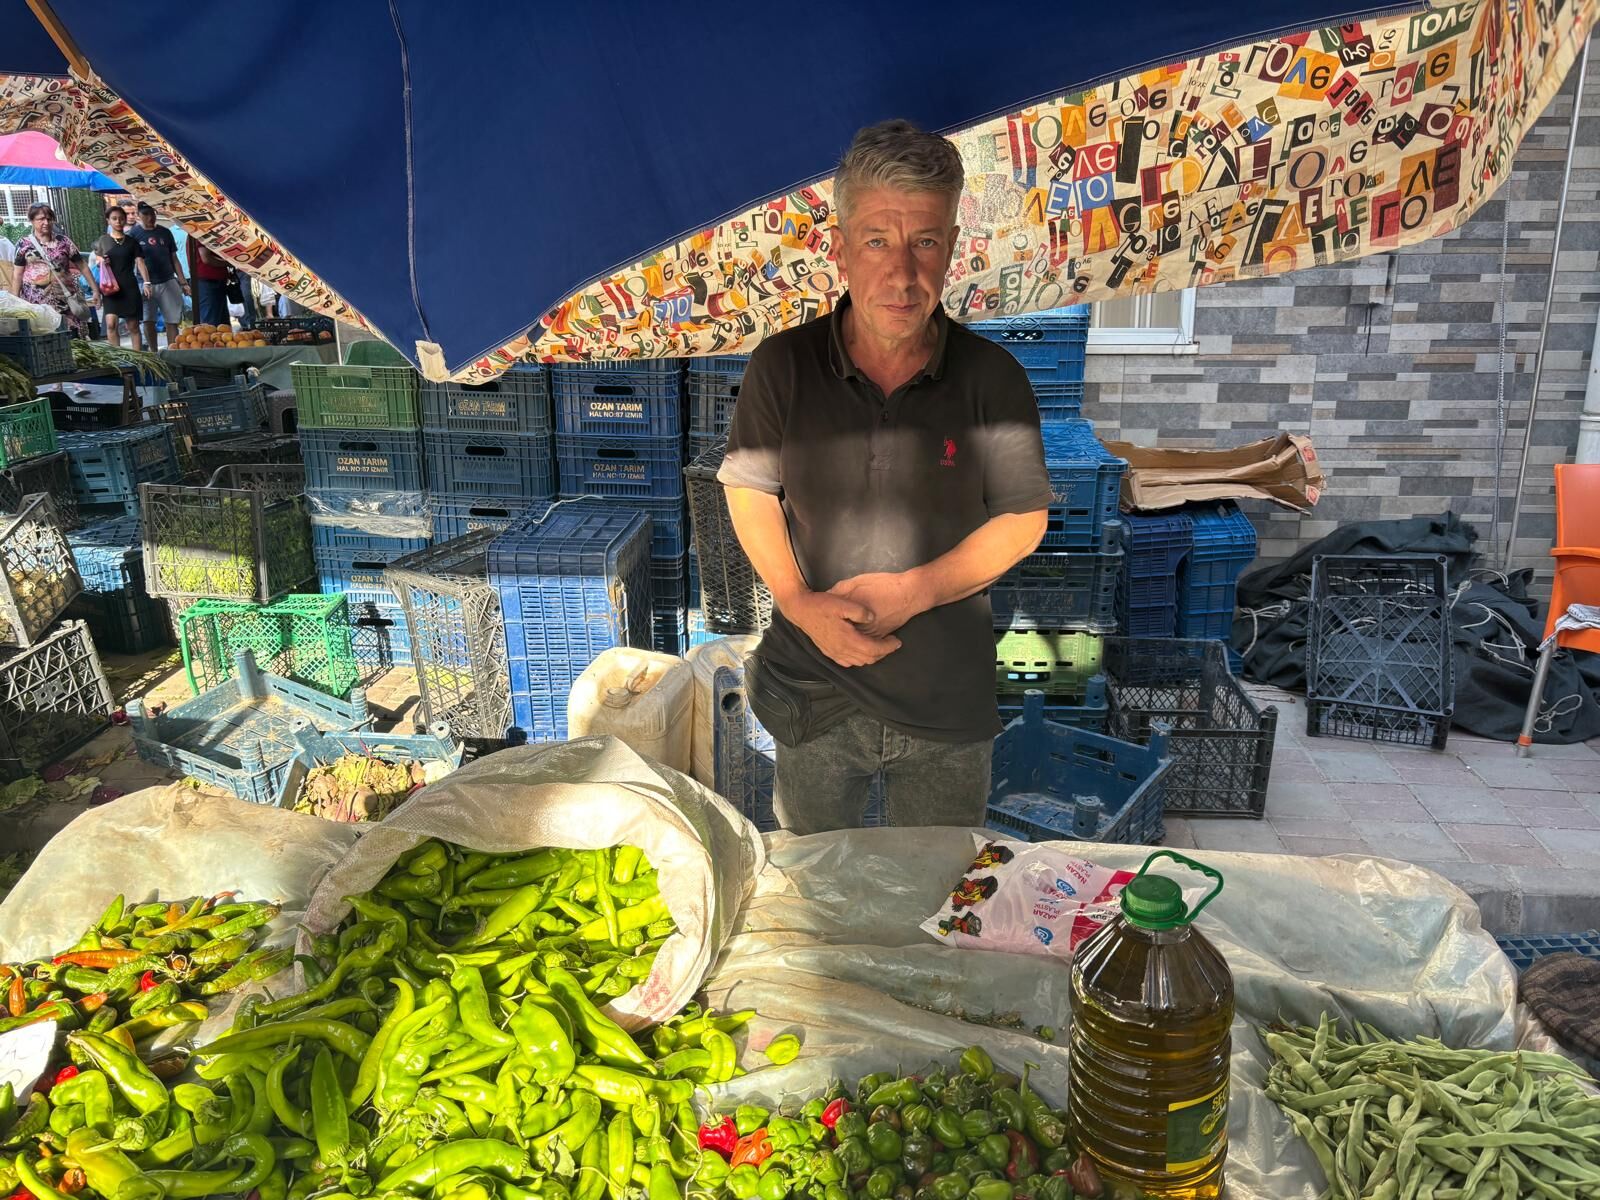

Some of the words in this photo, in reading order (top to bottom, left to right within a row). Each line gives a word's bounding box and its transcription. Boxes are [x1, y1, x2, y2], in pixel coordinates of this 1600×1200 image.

[590, 402, 614, 411] OZAN
[615, 403, 643, 412] TARIM
[337, 457, 360, 465] OZAN
[361, 457, 388, 466] TARIM
[593, 463, 617, 472] OZAN
[618, 464, 645, 473] TARIM
[351, 575, 373, 583] OZAN
[1065, 864, 1087, 885] NAZAR
[1033, 909, 1058, 920] NAZAR
